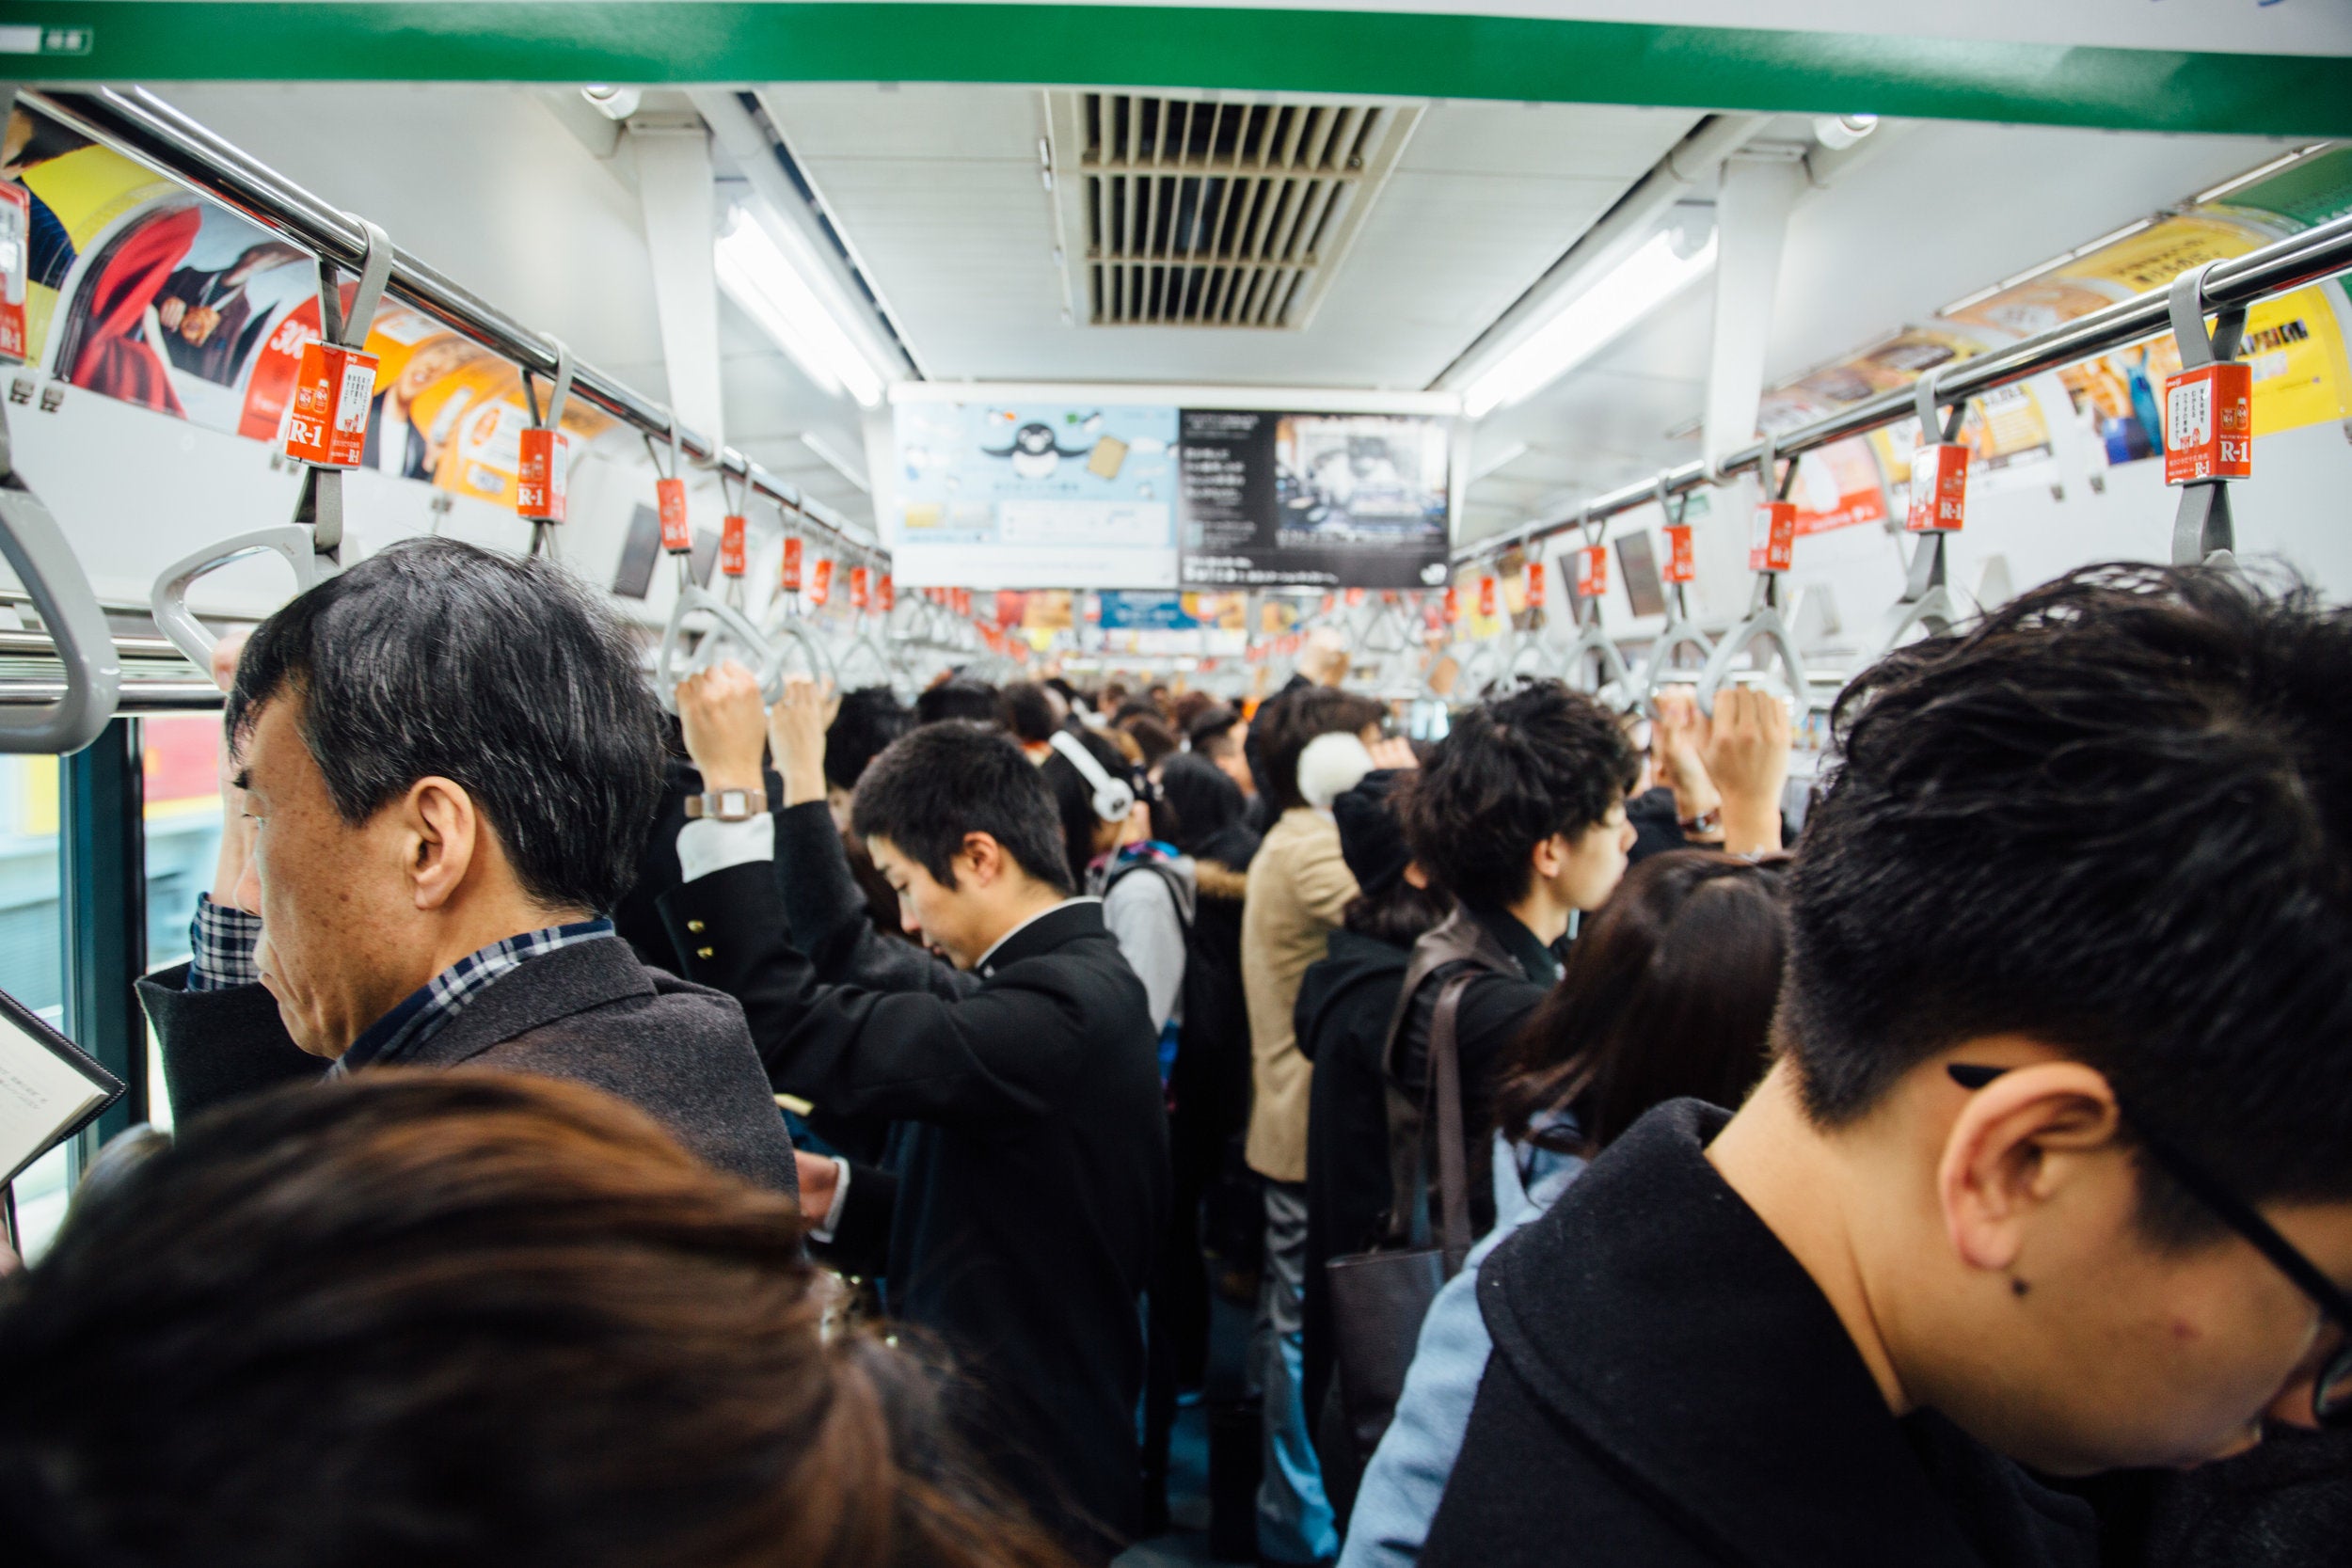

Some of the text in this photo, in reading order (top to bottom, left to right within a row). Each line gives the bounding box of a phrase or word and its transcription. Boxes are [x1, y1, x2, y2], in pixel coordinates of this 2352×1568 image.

[2166, 377, 2182, 388] meiji
[288, 420, 323, 448] R-1
[347, 449, 359, 464] R-1
[2220, 440, 2249, 463] R-1
[2195, 460, 2210, 476] R-1
[517, 487, 544, 507] R-1
[1940, 500, 1963, 520] R-1
